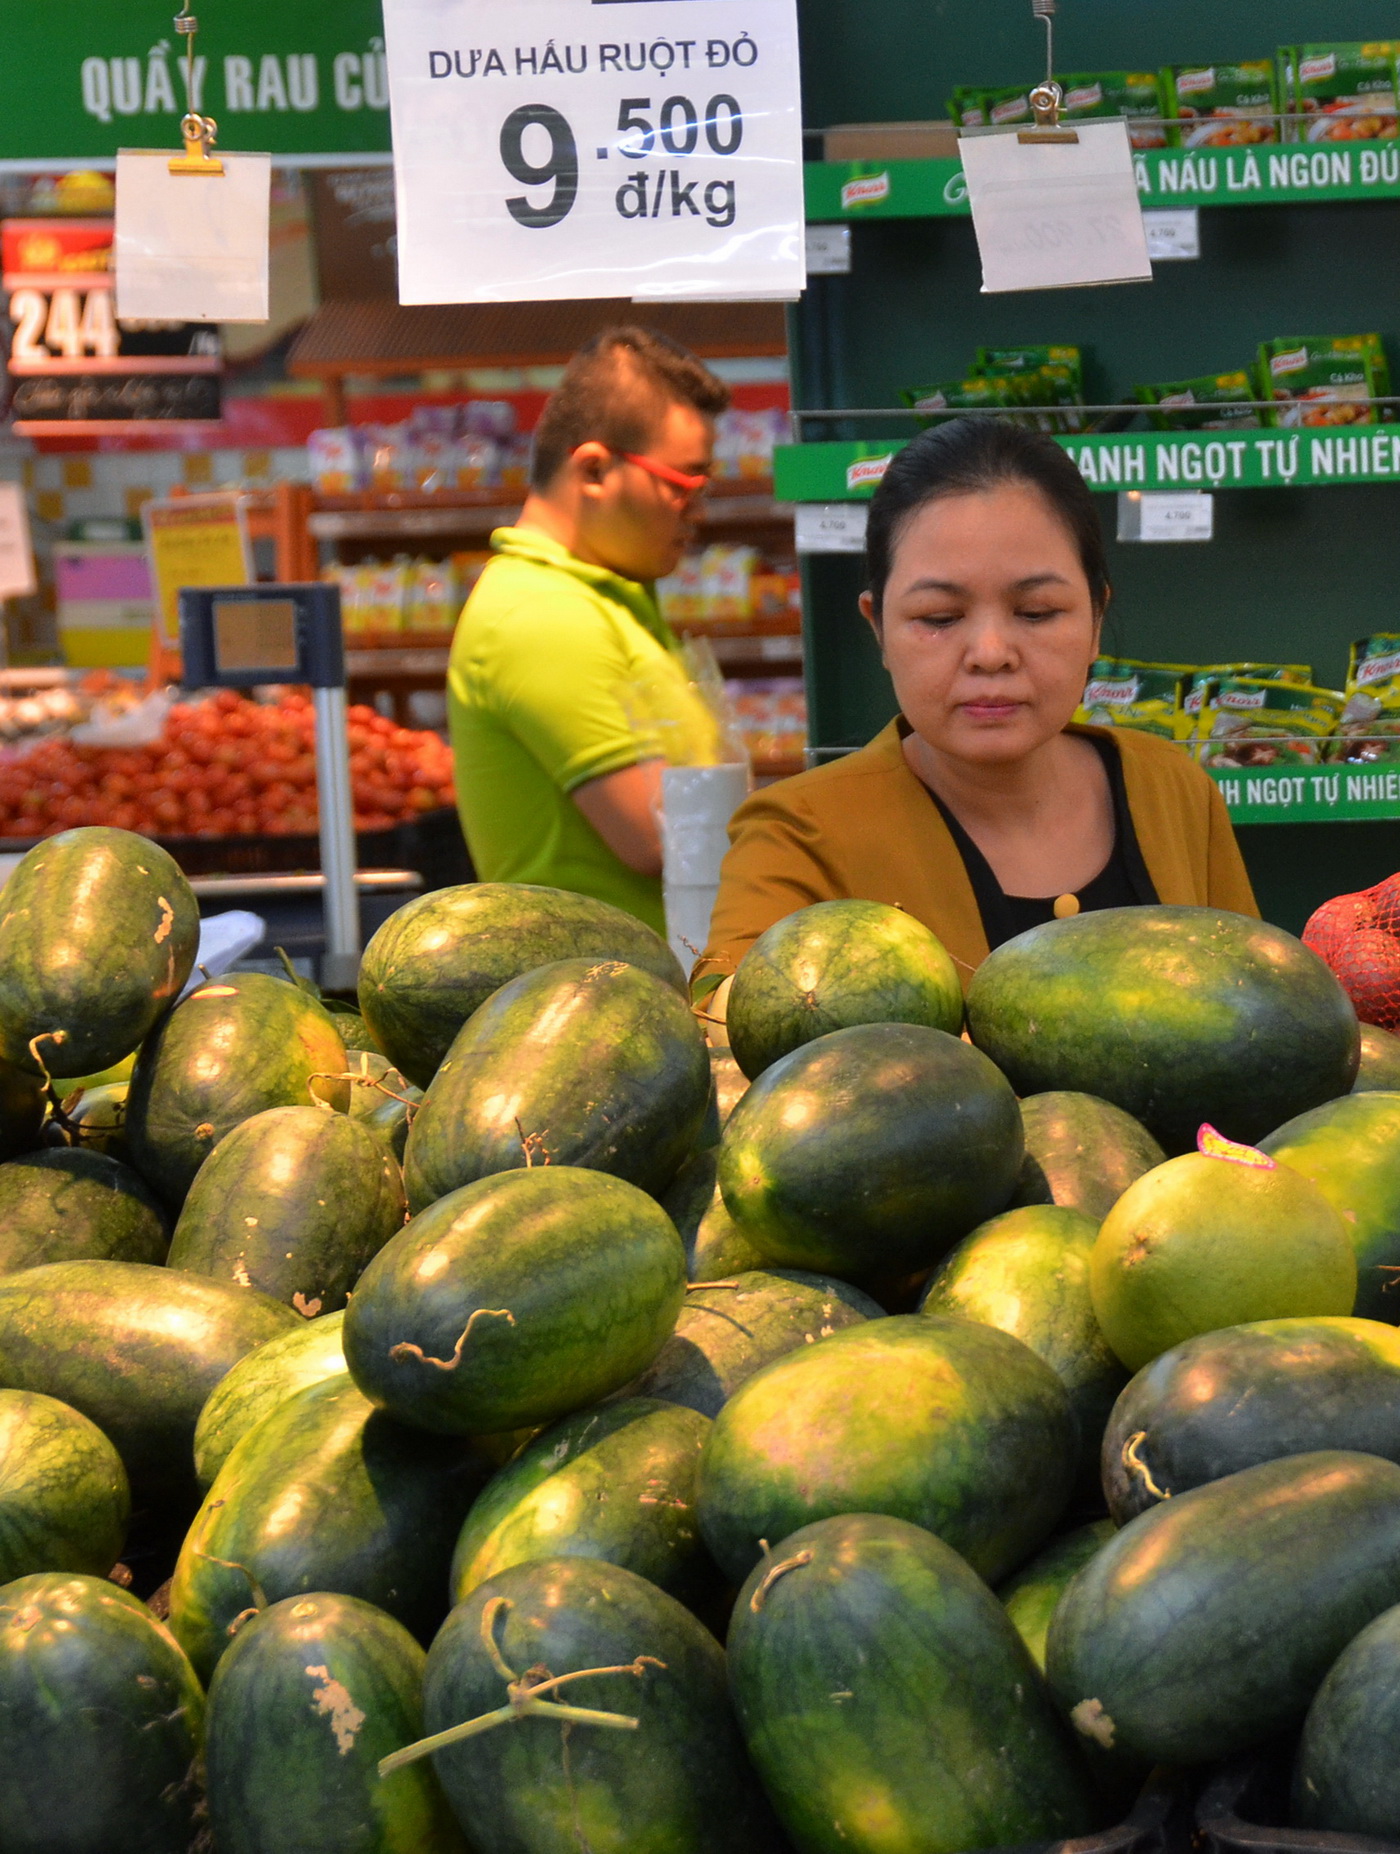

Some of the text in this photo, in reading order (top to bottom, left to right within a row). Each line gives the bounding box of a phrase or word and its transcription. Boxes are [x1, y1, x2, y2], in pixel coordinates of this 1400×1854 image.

[429, 31, 758, 79] DƯA HẤU RUỘT ĐỎ
[223, 53, 318, 112] RAU
[1158, 151, 1218, 194] NẤU
[1225, 148, 1262, 191] LÀ
[1269, 150, 1350, 188] NGON
[615, 169, 736, 228] đ/kg
[1067, 445, 1145, 484] ANH
[1156, 441, 1247, 488] NGỌT
[1254, 434, 1300, 485] TỰ
[1247, 776, 1305, 808] NGỌT
[1310, 772, 1340, 806] TỰ
